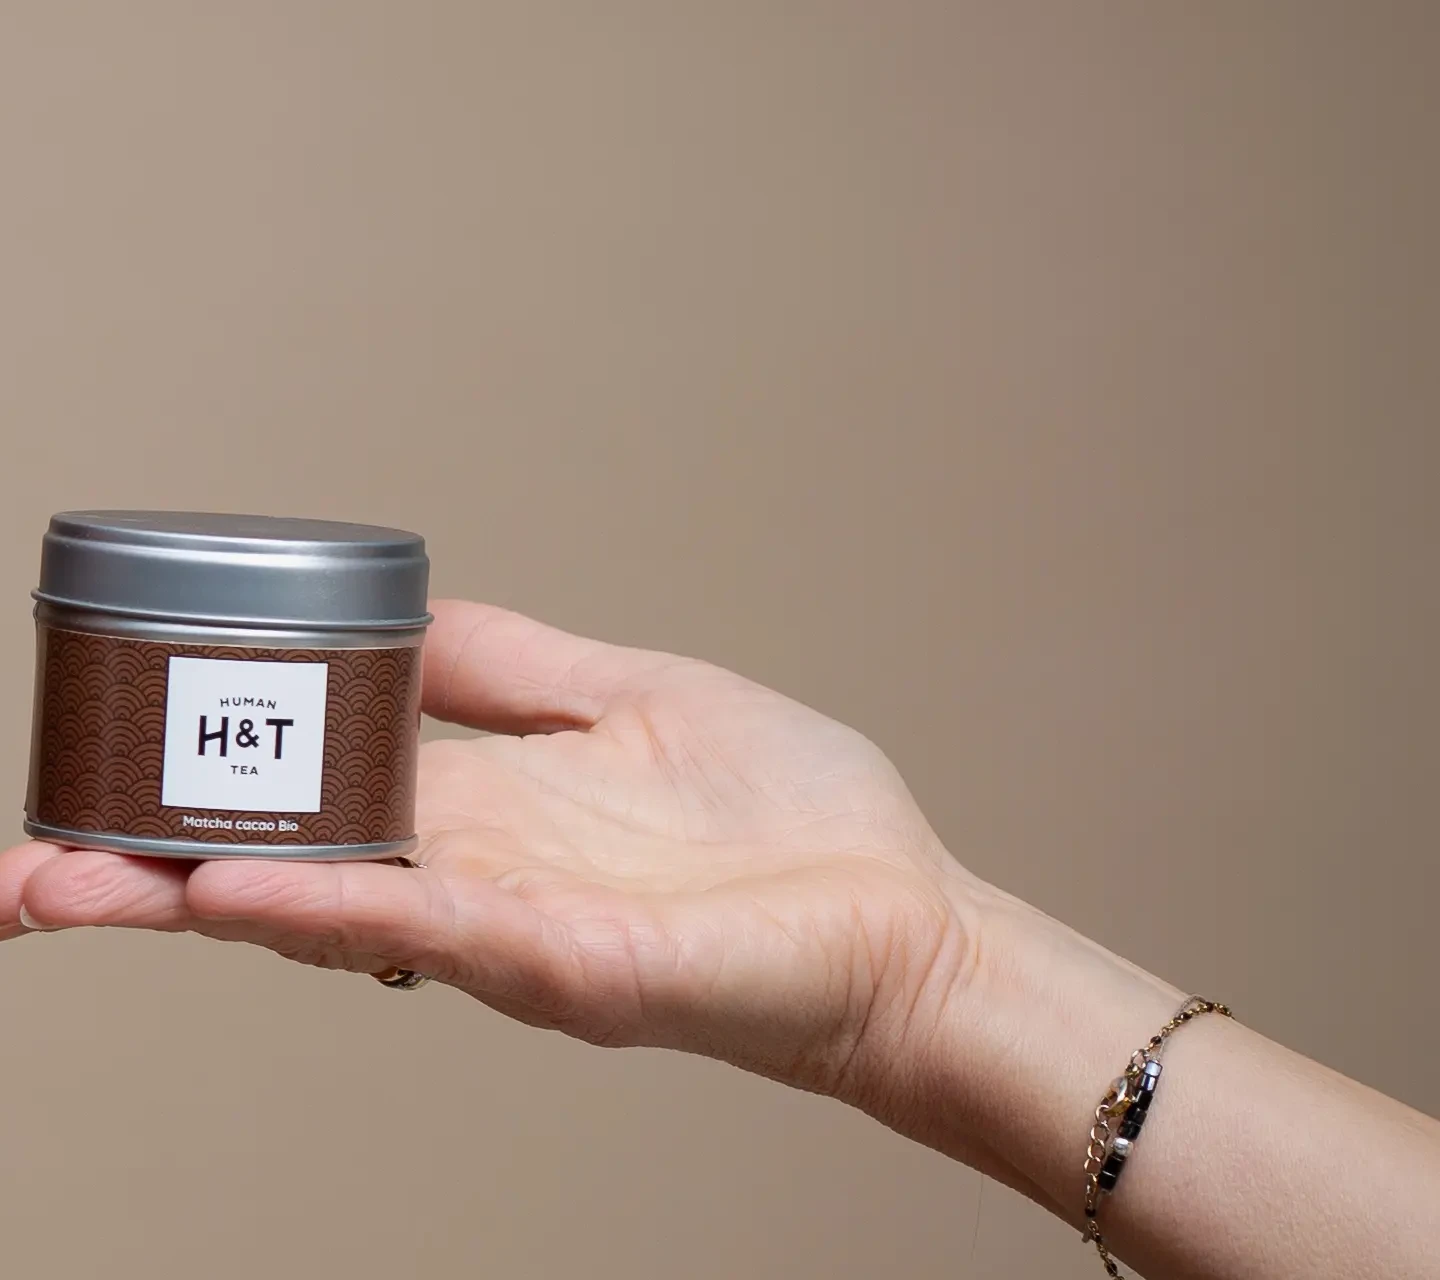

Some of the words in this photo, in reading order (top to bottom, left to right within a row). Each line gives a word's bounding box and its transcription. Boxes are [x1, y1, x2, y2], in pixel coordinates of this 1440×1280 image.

[219, 697, 277, 710] HUMAN
[197, 715, 294, 760] H&T
[230, 765, 259, 775] TEA
[182, 815, 232, 830] Matcha
[235, 820, 276, 831] cacao
[278, 819, 299, 832] Bio
